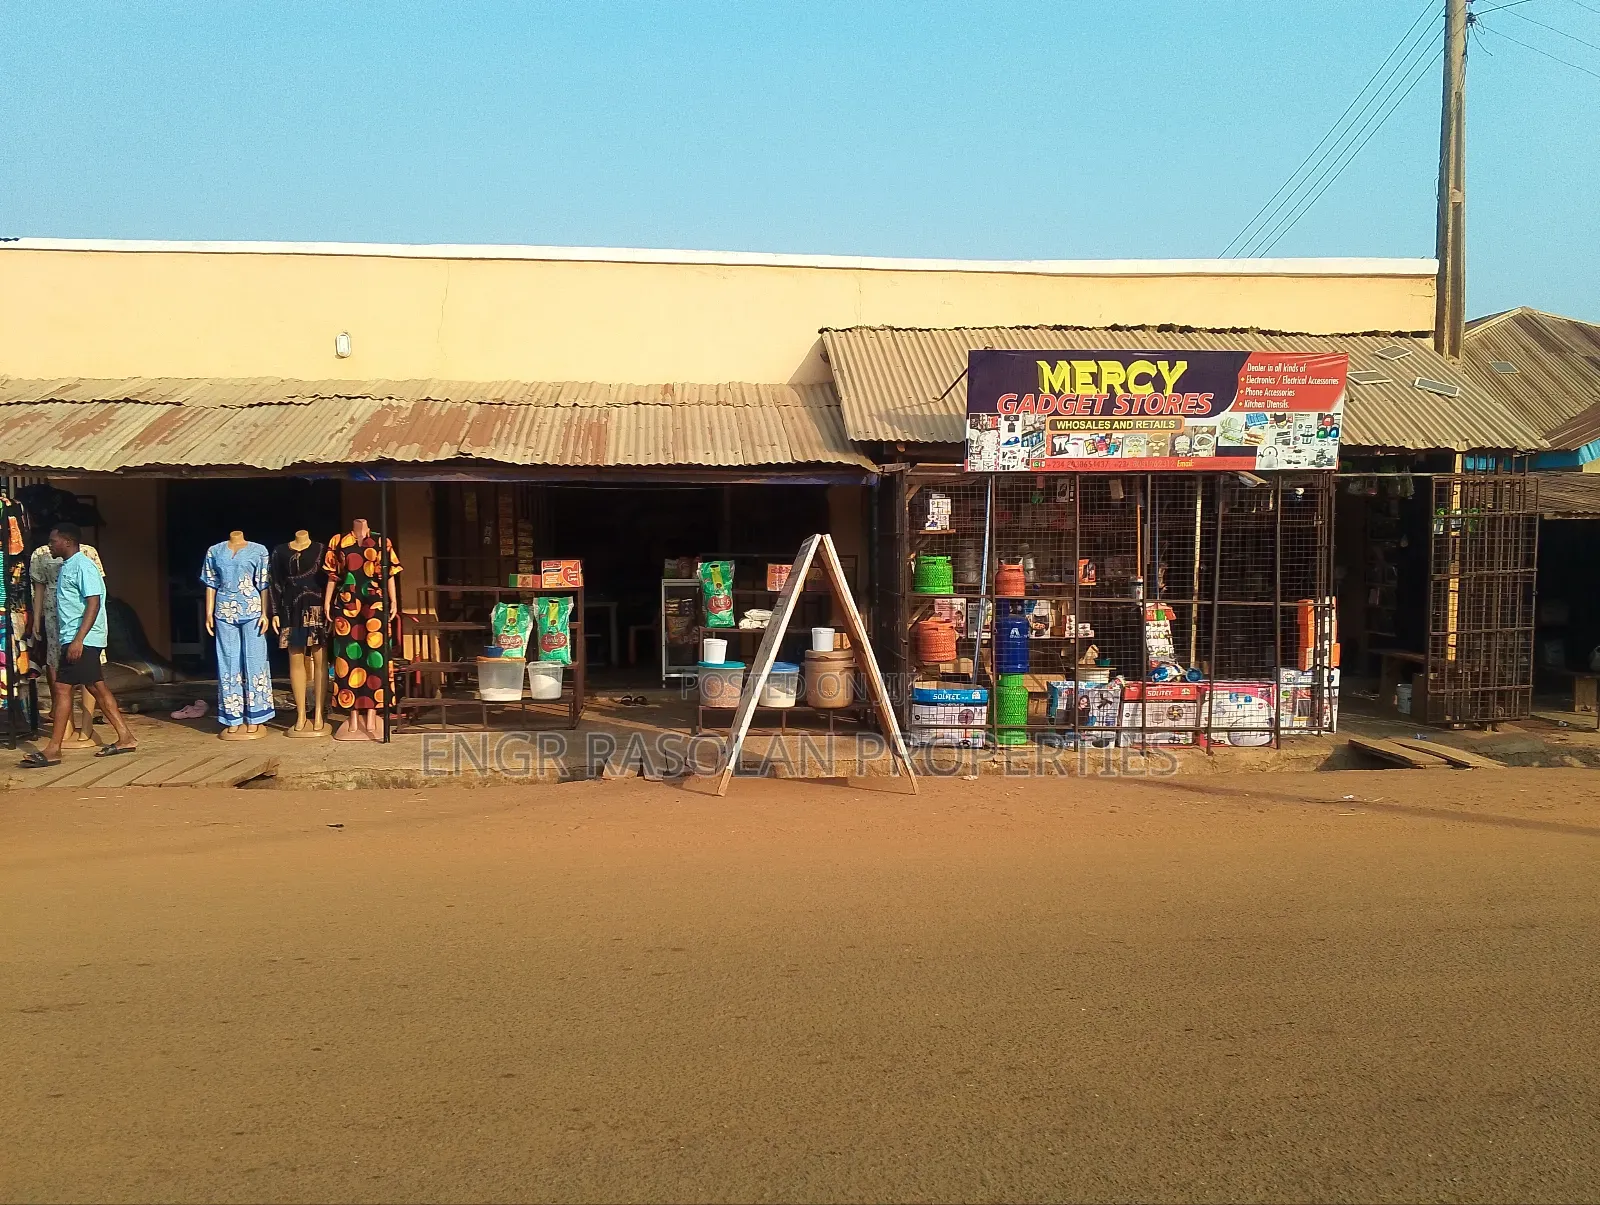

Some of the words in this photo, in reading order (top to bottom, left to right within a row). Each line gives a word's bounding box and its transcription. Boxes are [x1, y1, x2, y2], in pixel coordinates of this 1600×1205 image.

[1247, 362, 1266, 372] Dealer
[1267, 362, 1273, 372] in
[1274, 362, 1282, 372] all
[1283, 362, 1299, 373] kinds
[1299, 362, 1307, 373] of
[1036, 359, 1188, 396] MERCY
[1246, 374, 1276, 385] Electronics
[1282, 374, 1307, 385] Electrical
[1308, 376, 1339, 385] Accessories
[1245, 386, 1263, 397] Phone
[1264, 387, 1295, 397] Accessories
[997, 393, 1110, 415] GADGET
[1113, 393, 1214, 415] STORES
[1244, 399, 1265, 409] Kitchen
[1056, 419, 1111, 430] WHOSALES
[1112, 419, 1134, 429] AND
[1135, 419, 1176, 429] RETAILS
